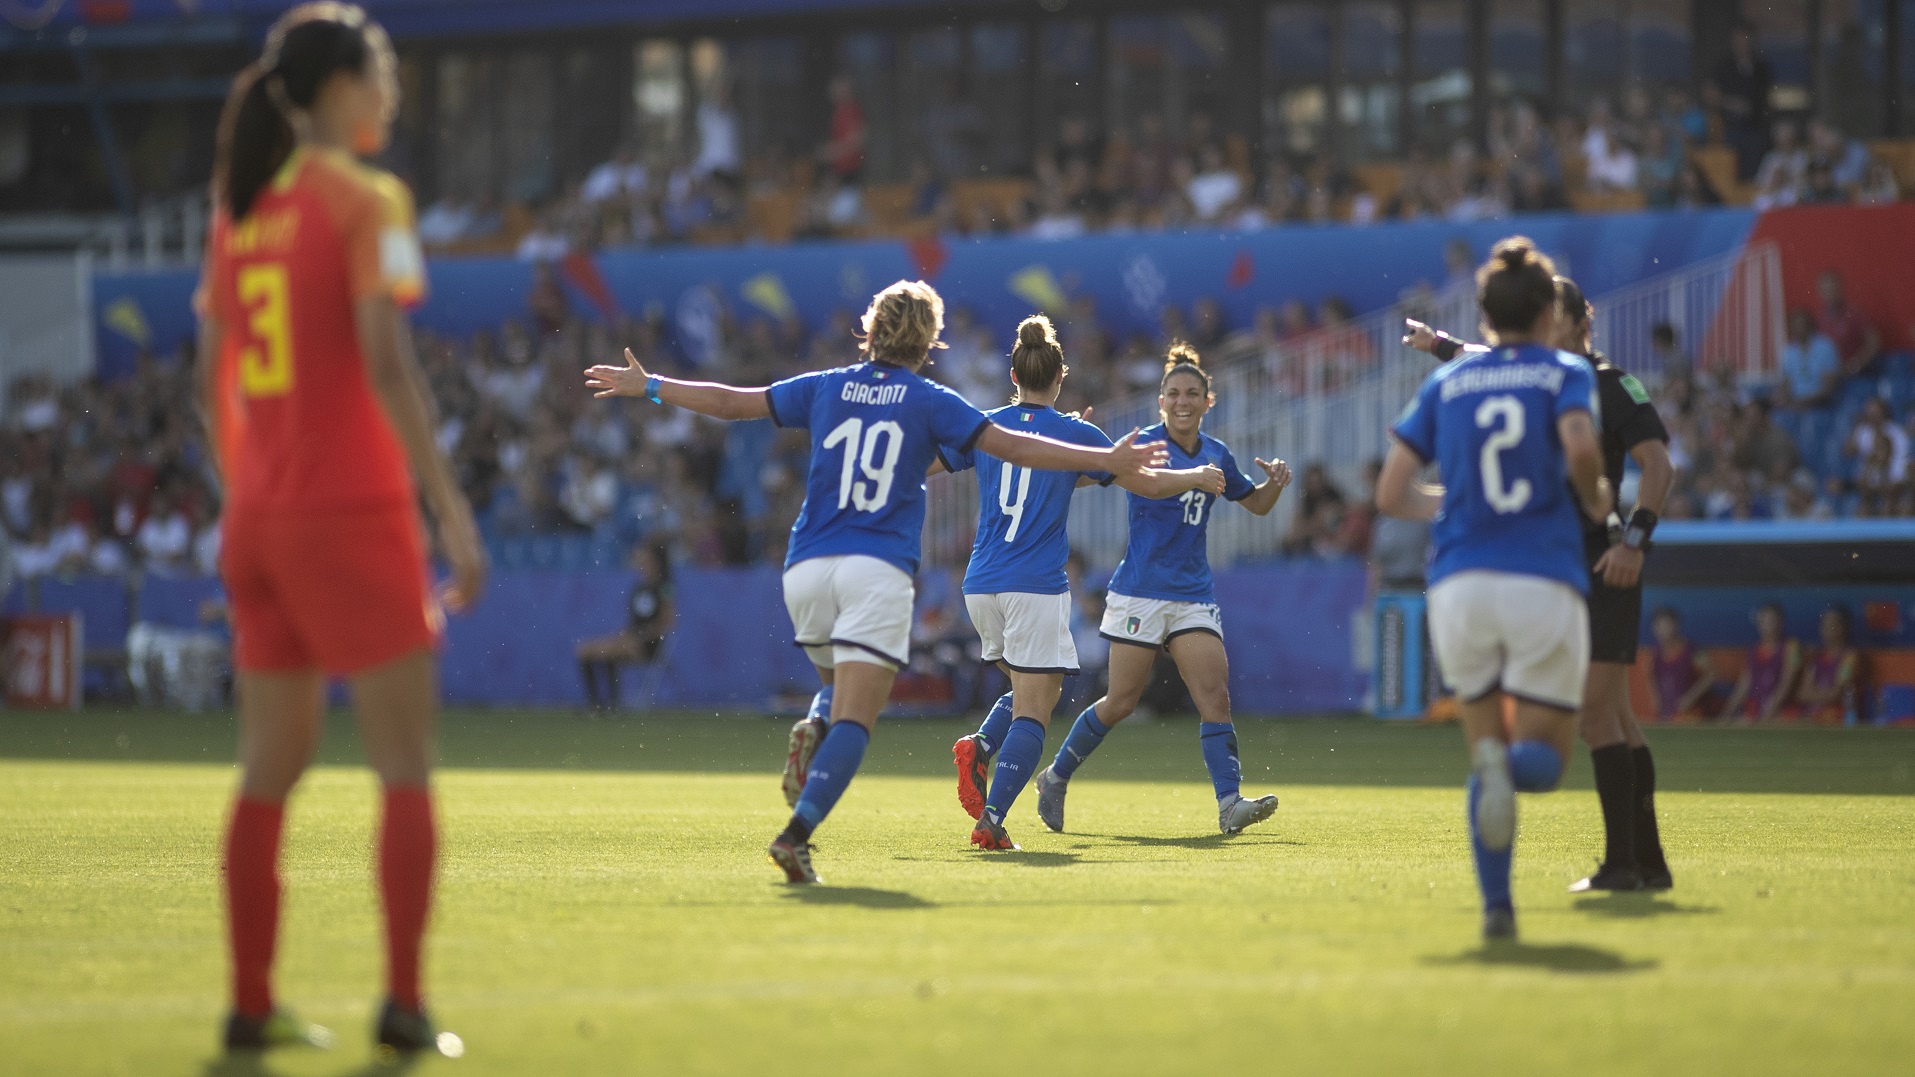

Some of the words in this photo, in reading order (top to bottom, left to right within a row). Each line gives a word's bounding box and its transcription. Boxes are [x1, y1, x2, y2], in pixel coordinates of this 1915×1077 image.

[238, 264, 293, 394] 3
[841, 381, 907, 405] GIACINTI
[823, 417, 904, 513] 19
[1475, 394, 1532, 514] 2
[999, 462, 1032, 542] 4
[1179, 490, 1206, 525] 13
